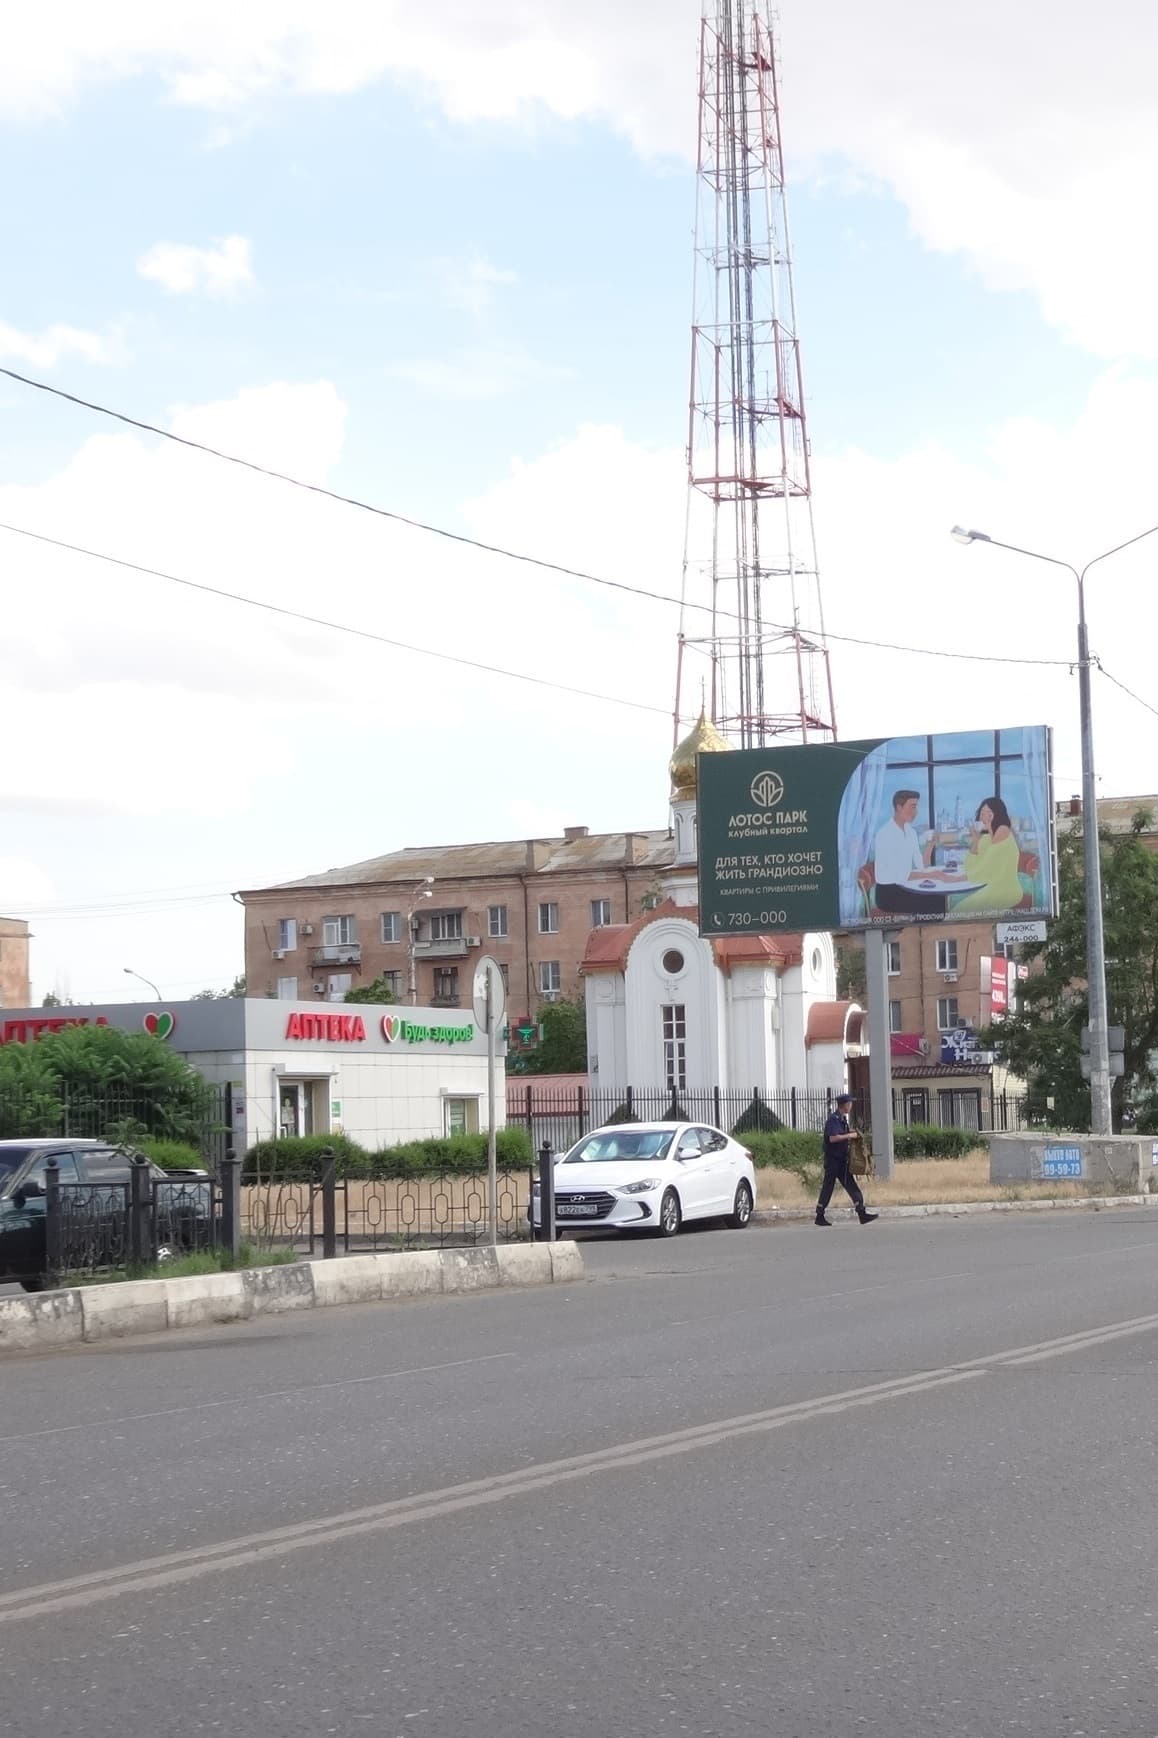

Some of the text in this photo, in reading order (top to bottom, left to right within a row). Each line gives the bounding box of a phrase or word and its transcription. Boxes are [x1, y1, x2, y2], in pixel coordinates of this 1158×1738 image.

[728, 810, 808, 828] ЛОТОС ПАРК
[728, 825, 808, 839] клубный квартал
[715, 851, 822, 869] ДЛЯ ТЕХ, КТО ХОЧЕТ
[715, 864, 823, 880] ЖИТЬ ГРАНДИОЗНО
[720, 887, 754, 896] КВАРТИРЫ
[755, 886, 761, 894] С
[728, 910, 787, 926] 730-000
[1007, 923, 1036, 933] АФЭКС
[285, 1012, 367, 1042] АПТЕКА
